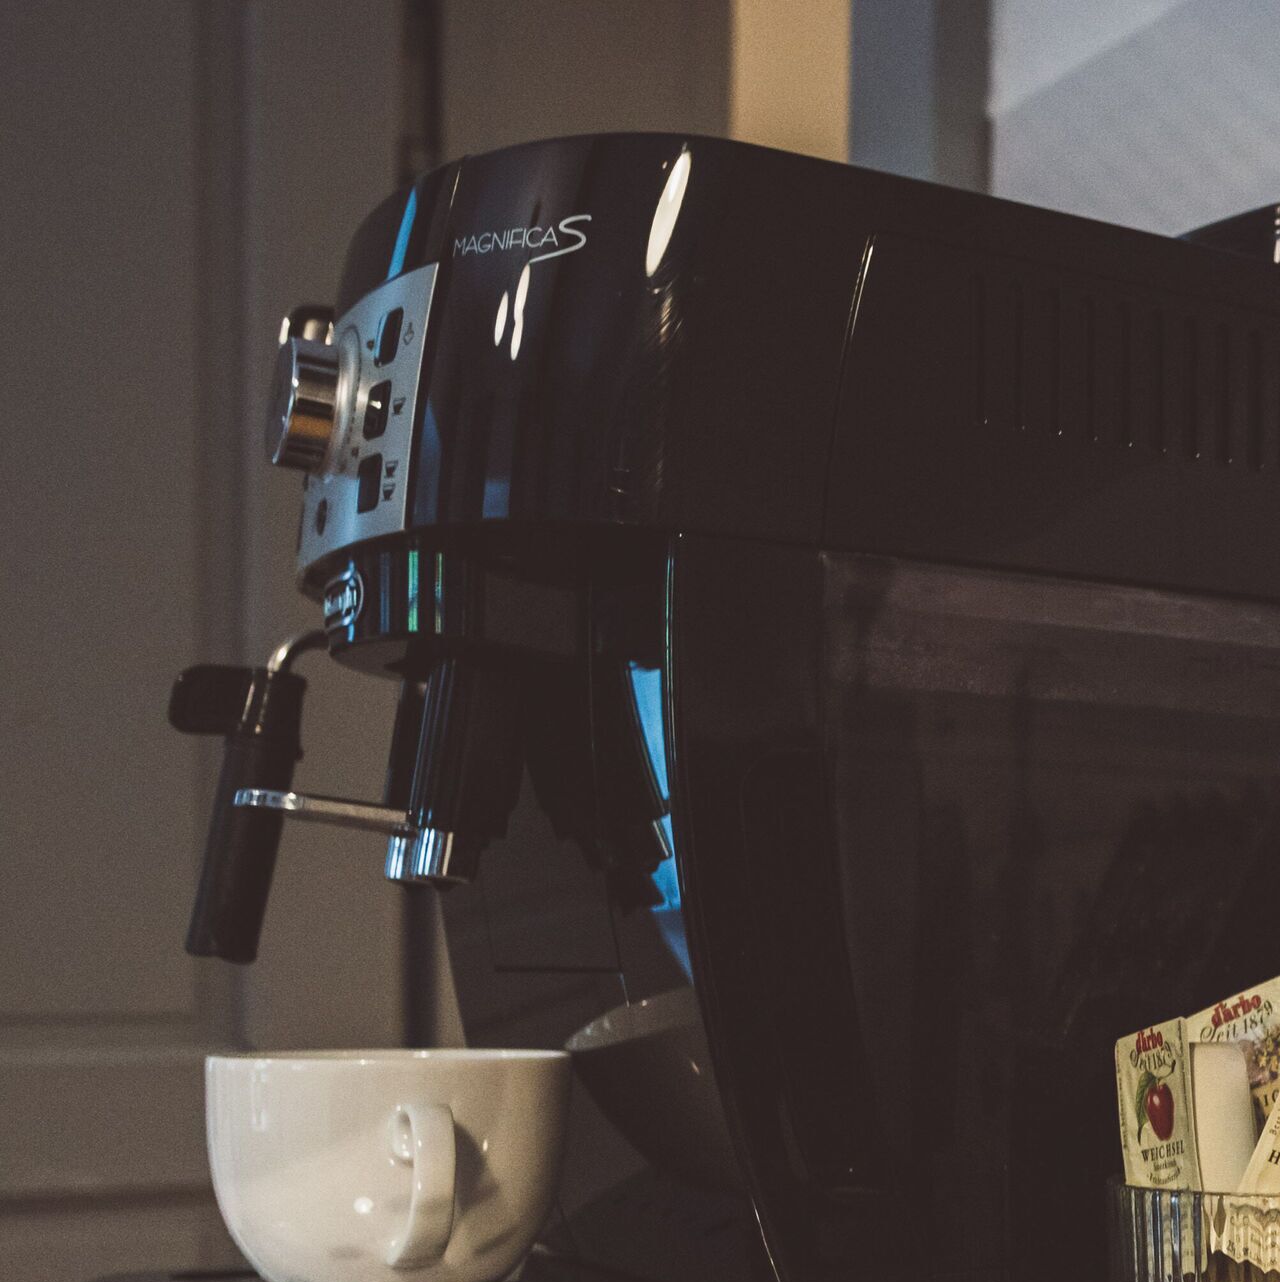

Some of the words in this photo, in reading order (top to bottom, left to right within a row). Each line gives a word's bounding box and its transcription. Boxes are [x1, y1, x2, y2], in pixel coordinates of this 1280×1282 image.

[452, 226, 559, 258] MAGNIFICA
[529, 214, 592, 264] S
[1141, 1139, 1185, 1162] WEICHSEL
